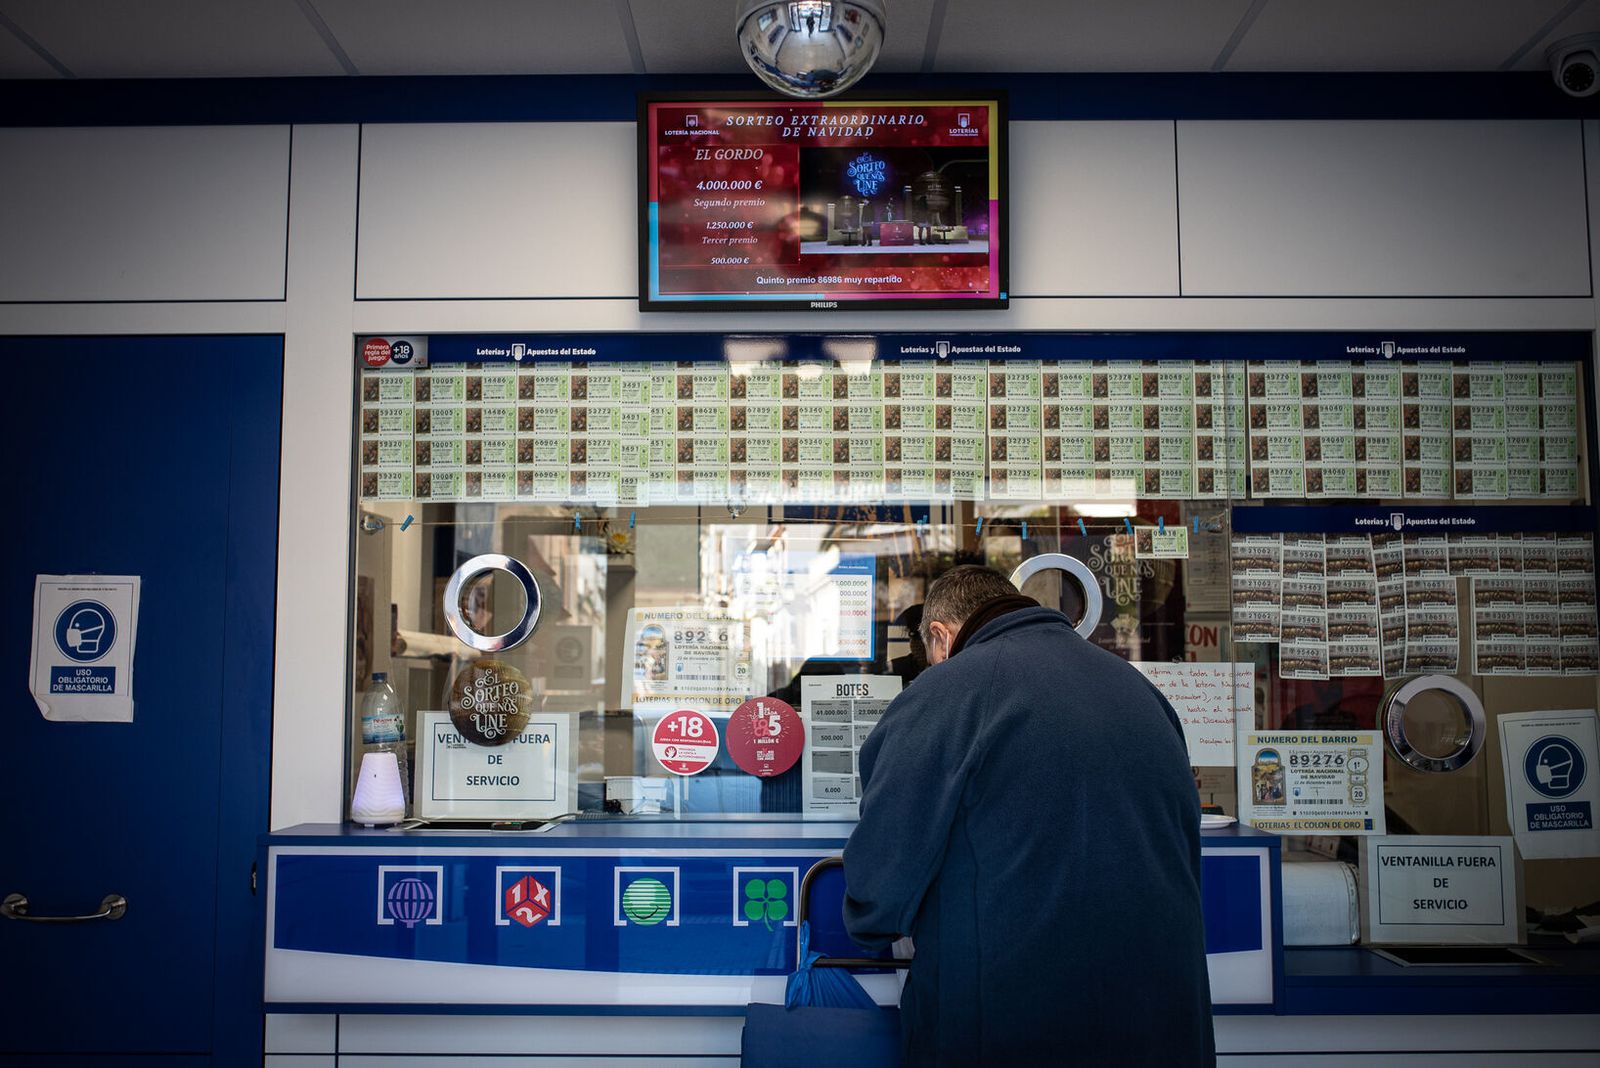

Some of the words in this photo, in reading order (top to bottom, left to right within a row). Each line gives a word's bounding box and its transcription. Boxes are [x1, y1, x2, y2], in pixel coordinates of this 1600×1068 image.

[726, 115, 784, 126] SORTEO
[791, 114, 925, 126] EXTRAORDINARIO
[782, 127, 801, 137] DE
[807, 127, 875, 137] NAVIDAD
[695, 148, 711, 160] EL
[715, 148, 764, 160] GORDO
[696, 180, 752, 190] 4.000.000
[754, 180, 763, 190] €
[694, 198, 731, 209] Segundo
[733, 199, 766, 210] premio
[706, 221, 746, 229] 1.250.000
[747, 221, 754, 229] €
[702, 236, 728, 245] Tercer
[728, 237, 758, 246] premio
[711, 257, 742, 265] 500.000
[743, 257, 750, 265] €
[756, 276, 785, 285] Quinto
[786, 277, 816, 285] premio
[817, 276, 843, 284] 86986
[844, 276, 862, 286] muy
[864, 275, 903, 285] repartido
[393, 345, 410, 354] +18
[476, 347, 505, 356] Loterías
[505, 349, 511, 357] y
[527, 348, 562, 357] Apuestas
[563, 347, 571, 355] del
[572, 347, 597, 356] Estado
[900, 345, 929, 354] Loterías
[929, 347, 936, 355] y
[951, 345, 984, 355] Apuestas
[984, 345, 996, 353] del
[997, 345, 1021, 353] Estado
[1346, 345, 1375, 354] Loterías
[1375, 347, 1381, 355] y
[1396, 346, 1429, 356] Apuestas
[1429, 345, 1441, 353] del
[1355, 517, 1384, 525] Loterías
[1384, 519, 1390, 527] y
[1405, 518, 1439, 527] Apuestas
[1439, 517, 1451, 525] del
[1451, 517, 1476, 526] Estado
[644, 612, 684, 620] NUMERO
[674, 630, 729, 642] 8926
[58, 676, 109, 684] OBLIGATORIO
[475, 669, 501, 687] EL
[52, 684, 63, 692] DE
[64, 684, 113, 692] MASCARILLA
[836, 683, 869, 696] BOTES
[460, 681, 519, 709] SORTEO
[475, 701, 496, 714] QUE
[497, 697, 519, 715] NOS
[725, 697, 742, 705] ORO
[756, 702, 764, 719] 1
[470, 713, 508, 739] UNE
[667, 716, 703, 738] +18
[768, 715, 782, 736] 5
[512, 733, 551, 744] FUERA
[1257, 736, 1298, 744] NUMERO
[1301, 735, 1319, 744] DEL
[1321, 735, 1358, 744] BARRIO
[487, 754, 503, 765] DE
[1289, 754, 1345, 766] 89276
[466, 775, 520, 786] SERVICIO
[1354, 790, 1363, 798] 20
[1550, 805, 1566, 813] USO
[1533, 812, 1584, 821] OBLIGATORIO
[1254, 821, 1291, 829] LOTERIAS
[1293, 821, 1303, 829] EL
[1303, 821, 1330, 829] COLON
[1331, 821, 1342, 829] DE
[1343, 821, 1361, 829] ORO
[1530, 821, 1541, 829] DE
[1541, 818, 1590, 828] MASCARILLA
[1381, 855, 1454, 868] VENTANILLA
[1456, 855, 1497, 868] FUERA
[1433, 877, 1449, 888] DE
[511, 882, 521, 904] 1
[1413, 898, 1468, 910] SERVICIO
[515, 907, 543, 924] 2
